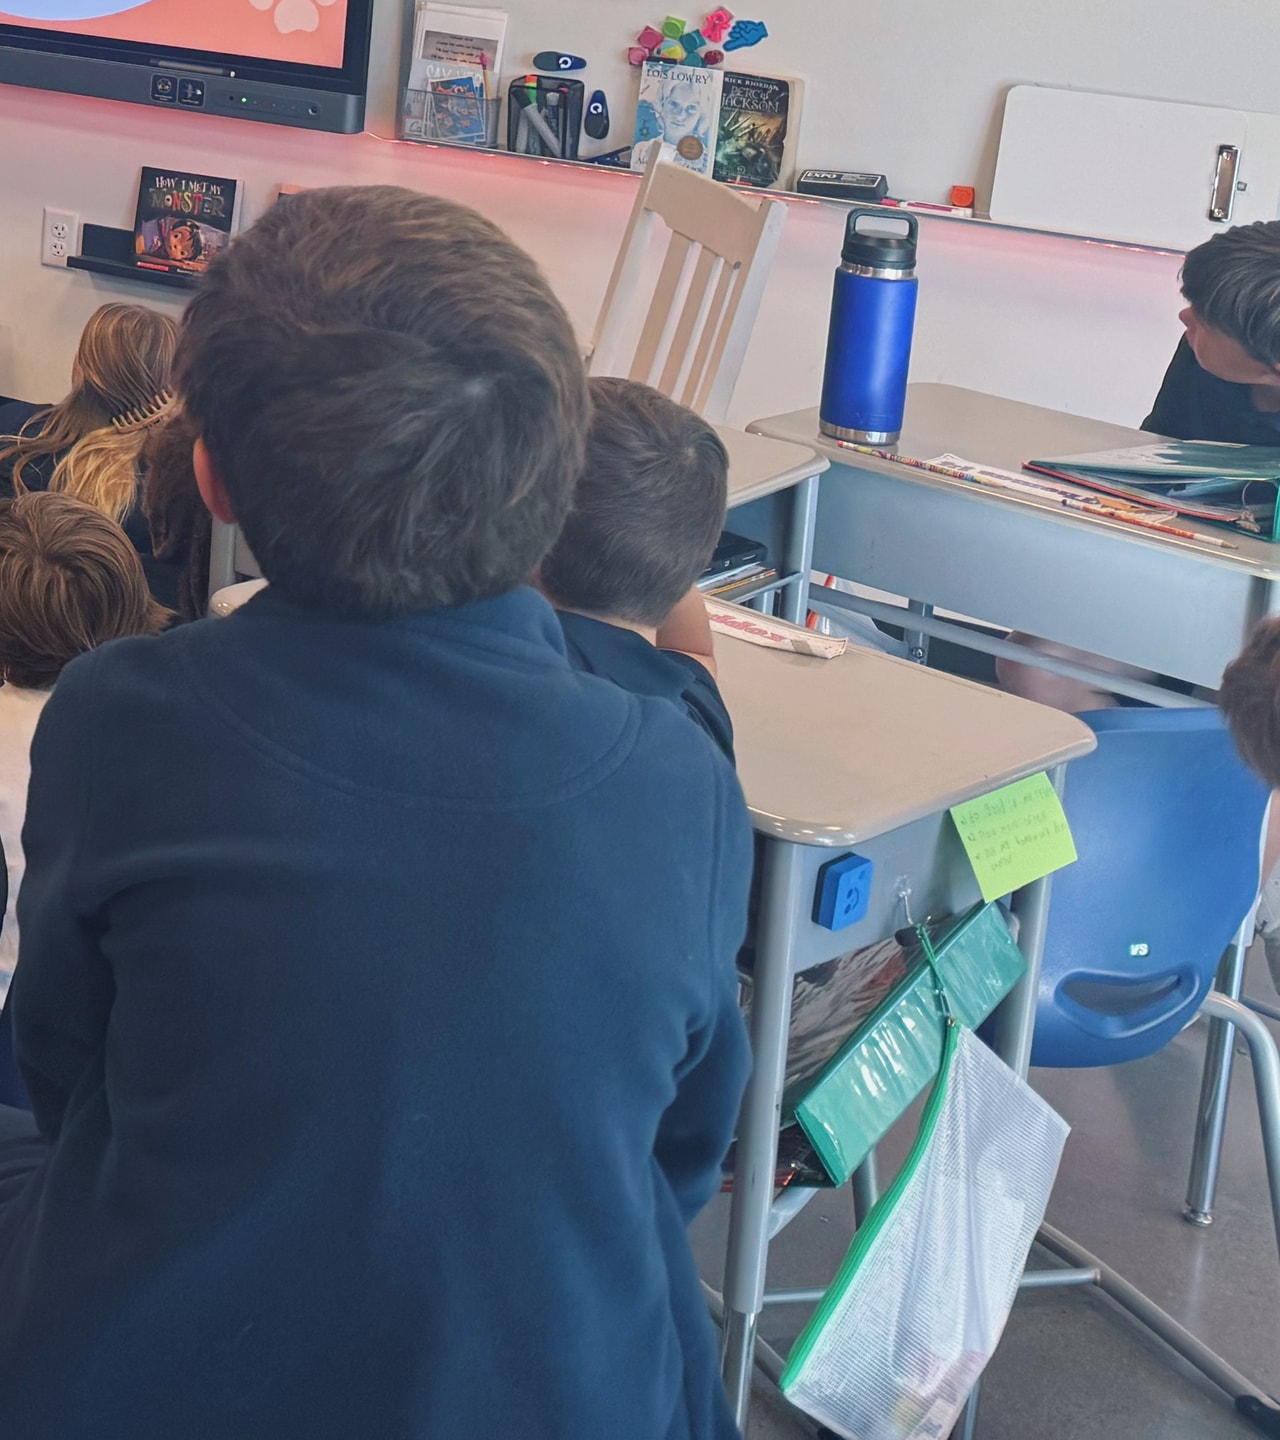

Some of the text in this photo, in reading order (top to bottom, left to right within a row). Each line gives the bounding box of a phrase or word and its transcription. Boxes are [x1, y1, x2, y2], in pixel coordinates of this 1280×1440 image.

[646, 68, 711, 85] LOIS LOWRY
[725, 77, 742, 85] RICK
[721, 92, 780, 113] JACKSON
[155, 176, 178, 189] HOW
[807, 172, 837, 180] EXPO
[149, 188, 227, 218] MONSTER
